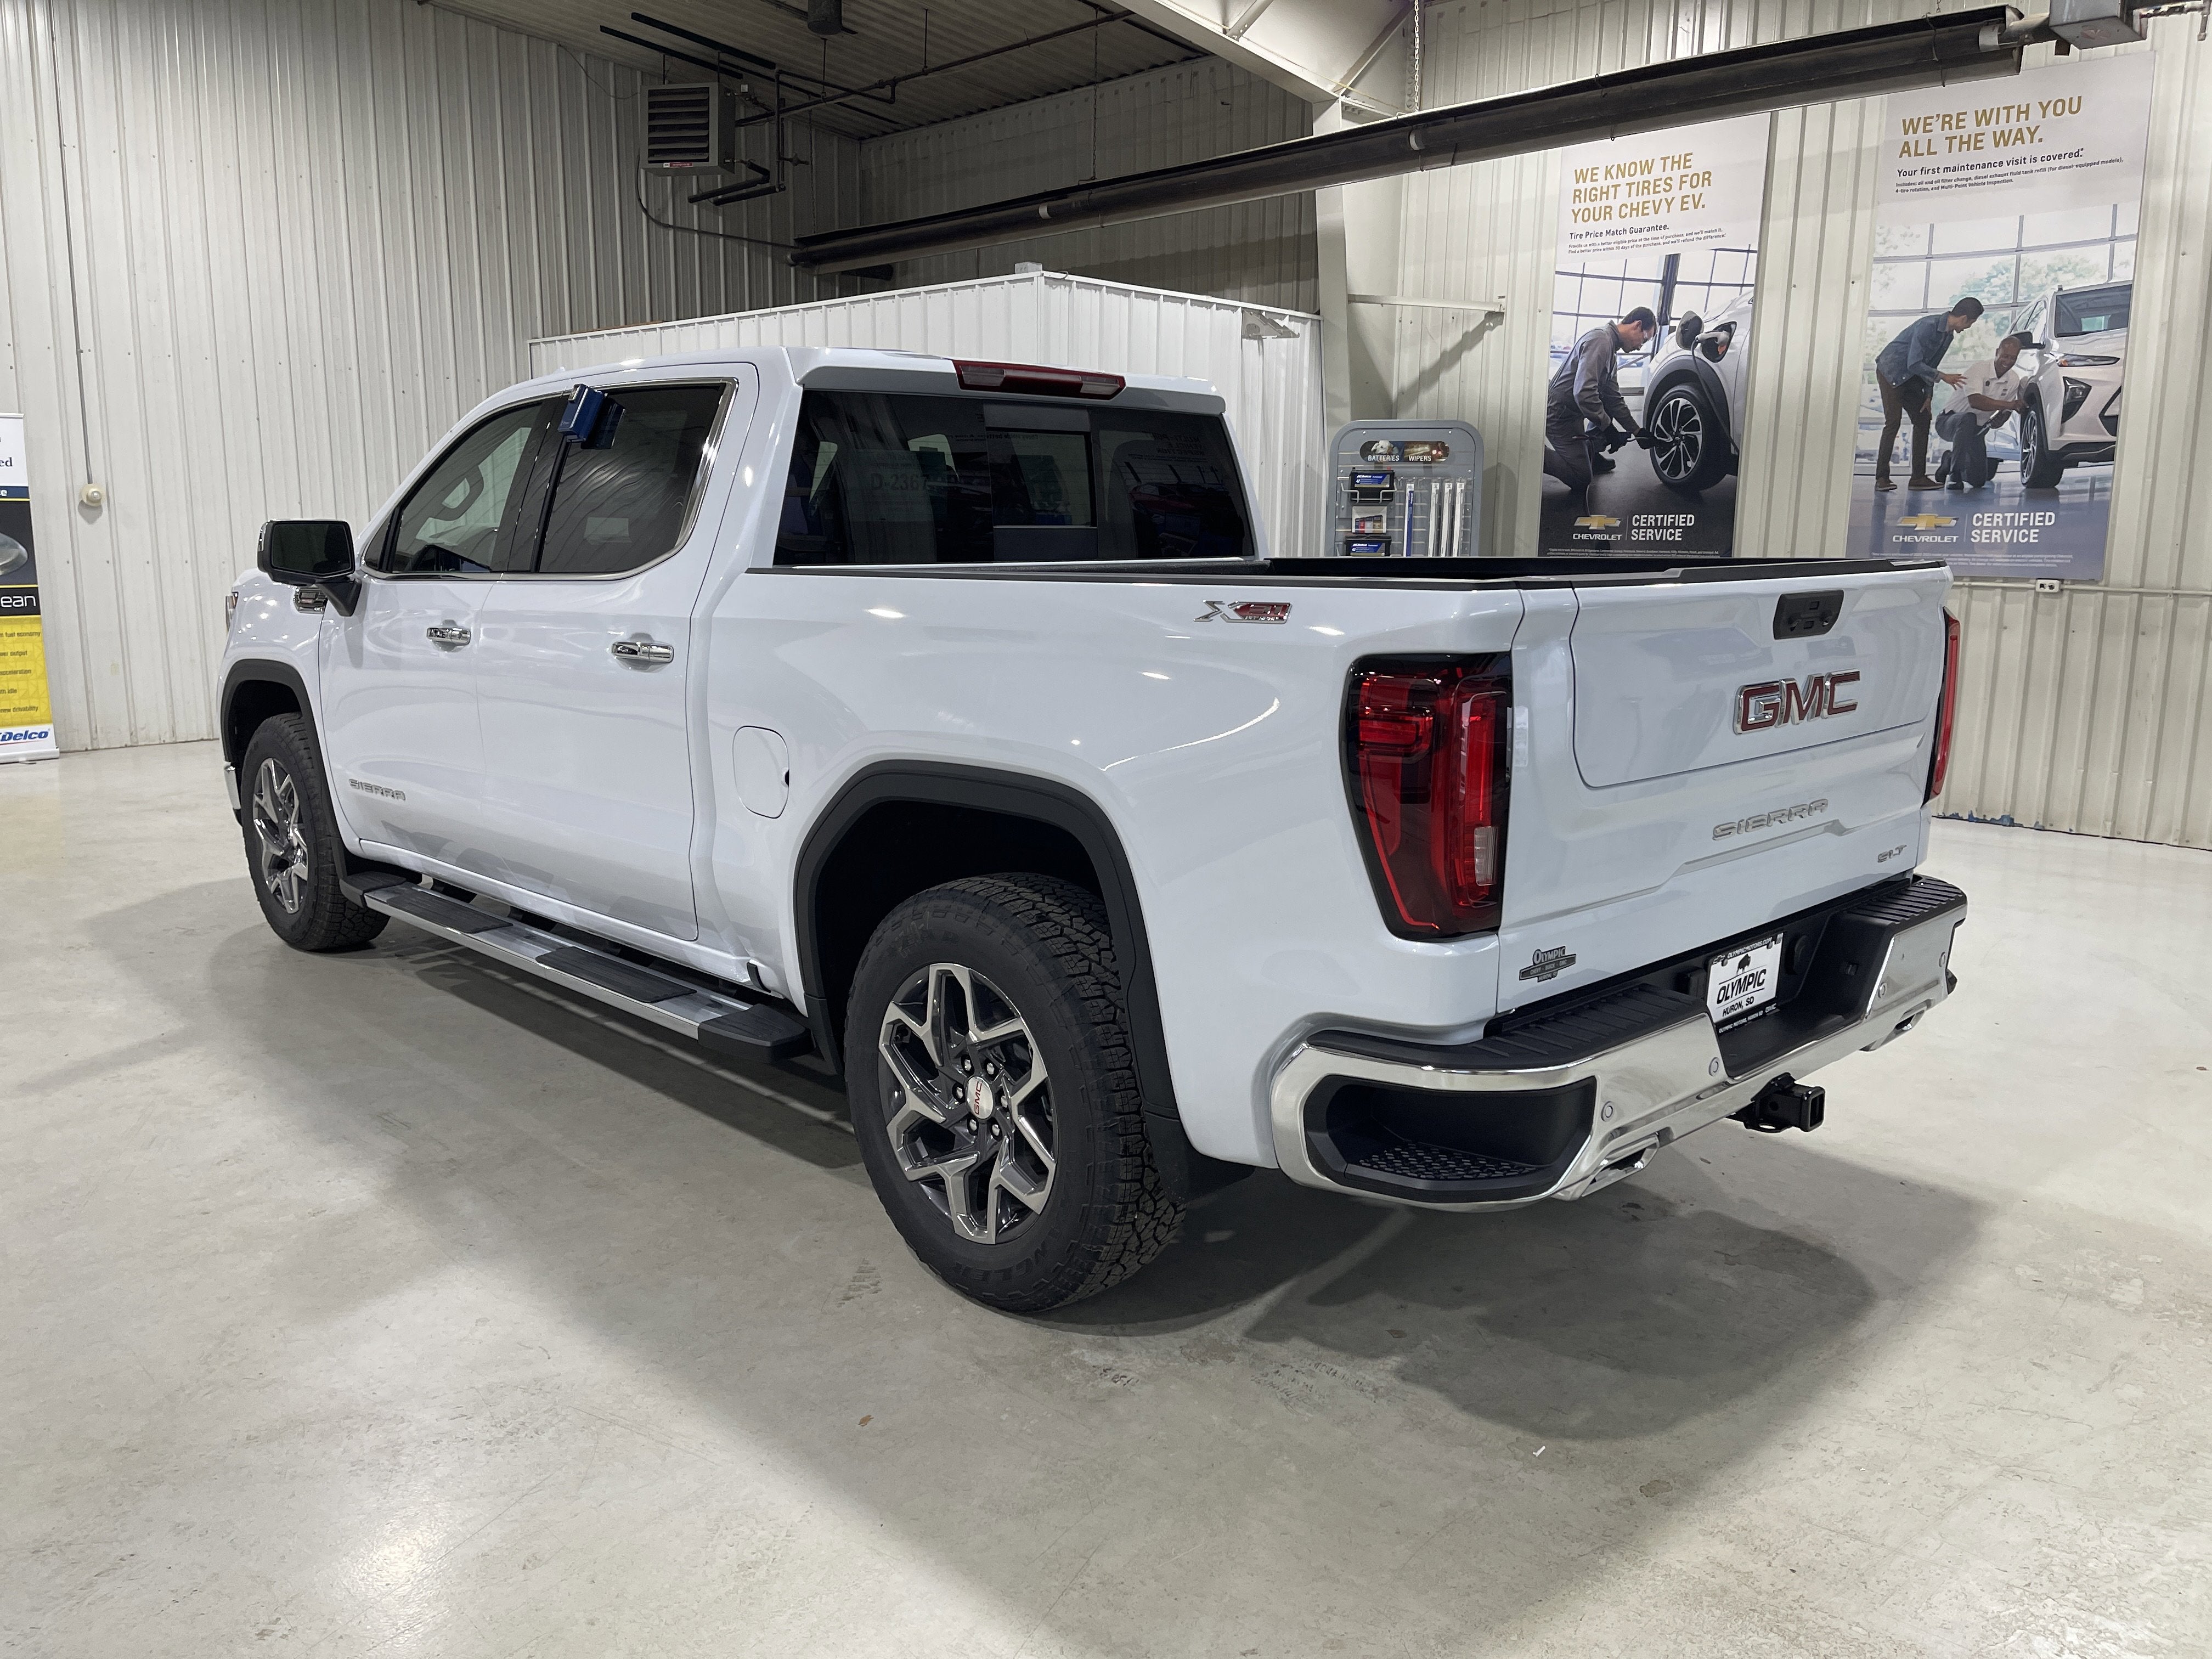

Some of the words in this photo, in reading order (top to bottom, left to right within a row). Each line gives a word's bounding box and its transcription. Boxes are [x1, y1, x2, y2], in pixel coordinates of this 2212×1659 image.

[1901, 111, 1967, 136] WE'RE
[1974, 103, 2030, 127] WITH
[2038, 95, 2082, 119] YOU
[1899, 138, 1937, 158] ALL
[1945, 132, 1985, 153] THE
[1993, 125, 2043, 148] WAY.
[1575, 167, 1599, 184] WE
[1605, 159, 1655, 180] KNOW
[1660, 153, 1693, 172] THE
[1897, 169, 1917, 177] Your
[1920, 166, 1940, 175] first
[1943, 160, 2003, 173] maintenance
[2006, 156, 2027, 166] visit
[2029, 155, 2037, 163] is
[1573, 184, 1621, 204] RIGHT
[1626, 176, 1673, 198] TIRES
[1679, 171, 1712, 191] FOR
[1571, 205, 1613, 223] YOUR
[1618, 196, 1675, 219] CHEVY
[1680, 193, 1706, 212] EV.
[1585, 230, 1603, 239] Price
[1605, 228, 1627, 236] Match
[1629, 224, 1669, 234] Guarantee.
[1632, 514, 1695, 527] CERTIFIED
[1972, 511, 2056, 527] CERTIFIED
[1630, 528, 1683, 541] SERVICE
[1892, 534, 1959, 543] CHEVROLET
[1971, 528, 2039, 543] SERVICE
[1, 595, 36, 607] ean
[1733, 669, 1860, 735] GMC
[348, 778, 406, 801] SIERRA
[1712, 798, 1829, 840] SIERRA
[1877, 844, 1907, 862] SLT
[1533, 947, 1566, 964] OLYMPIC
[1717, 968, 1767, 1005] OLYMPIC
[1722, 1001, 1743, 1017] HURON,
[1745, 996, 1754, 1006] SD
[974, 1081, 983, 1115] GMC
